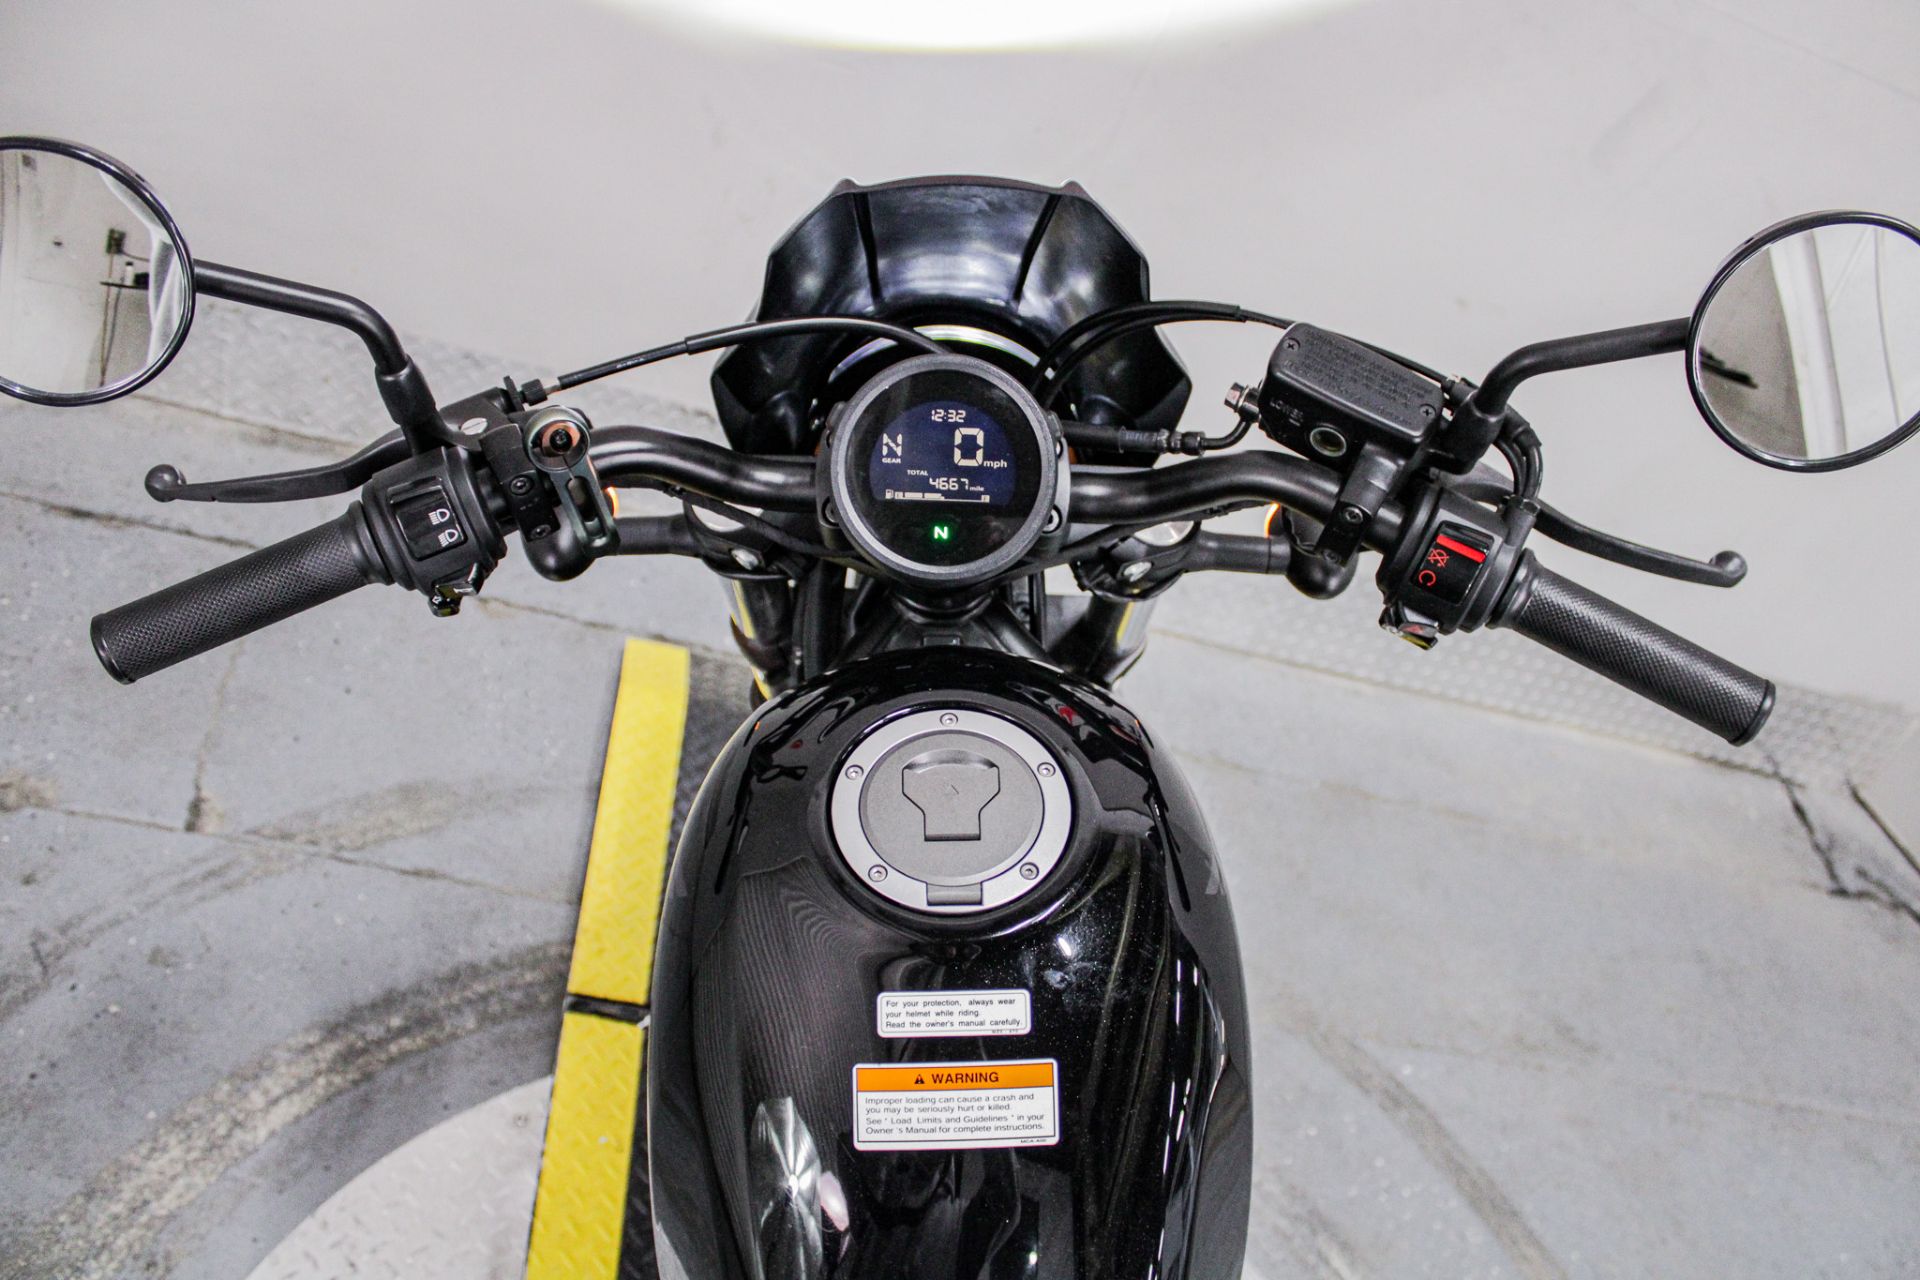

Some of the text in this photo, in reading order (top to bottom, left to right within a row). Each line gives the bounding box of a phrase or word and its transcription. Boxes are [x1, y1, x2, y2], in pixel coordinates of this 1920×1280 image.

[931, 409, 966, 423] 12:32
[882, 433, 902, 456] N
[954, 428, 1007, 469] 0 mph
[906, 469, 929, 477] TOTAL
[929, 477, 969, 491] 4667
[934, 526, 948, 539] N
[885, 998, 1016, 1009] For your protection, always wear
[885, 1011, 902, 1019] your
[905, 1010, 931, 1018] helmet
[934, 1009, 954, 1017] while
[885, 1020, 906, 1029] Read
[909, 1020, 922, 1028] the
[925, 1020, 955, 1028] owner's
[958, 1018, 986, 1027] manual
[931, 1071, 1000, 1085] WARNING
[865, 1097, 903, 1106] Improper
[905, 1096, 937, 1106] loading
[956, 1095, 983, 1103] cause
[992, 1094, 1016, 1102] crash
[1018, 1092, 1035, 1101] and
[865, 1107, 881, 1116] you
[883, 1106, 901, 1115] may
[904, 1105, 914, 1113] be
[917, 1105, 955, 1114] seriously
[957, 1104, 975, 1112] hurt
[976, 1103, 985, 1111] or
[865, 1117, 882, 1126] See
[917, 1115, 942, 1124] Limits
[944, 1115, 961, 1123] and
[1016, 1113, 1025, 1121] in
[1026, 1112, 1045, 1122] your
[905, 1125, 937, 1134] Manual
[938, 1124, 951, 1133] for
[953, 1124, 992, 1133] complete
[994, 1121, 1044, 1132] instructions.
